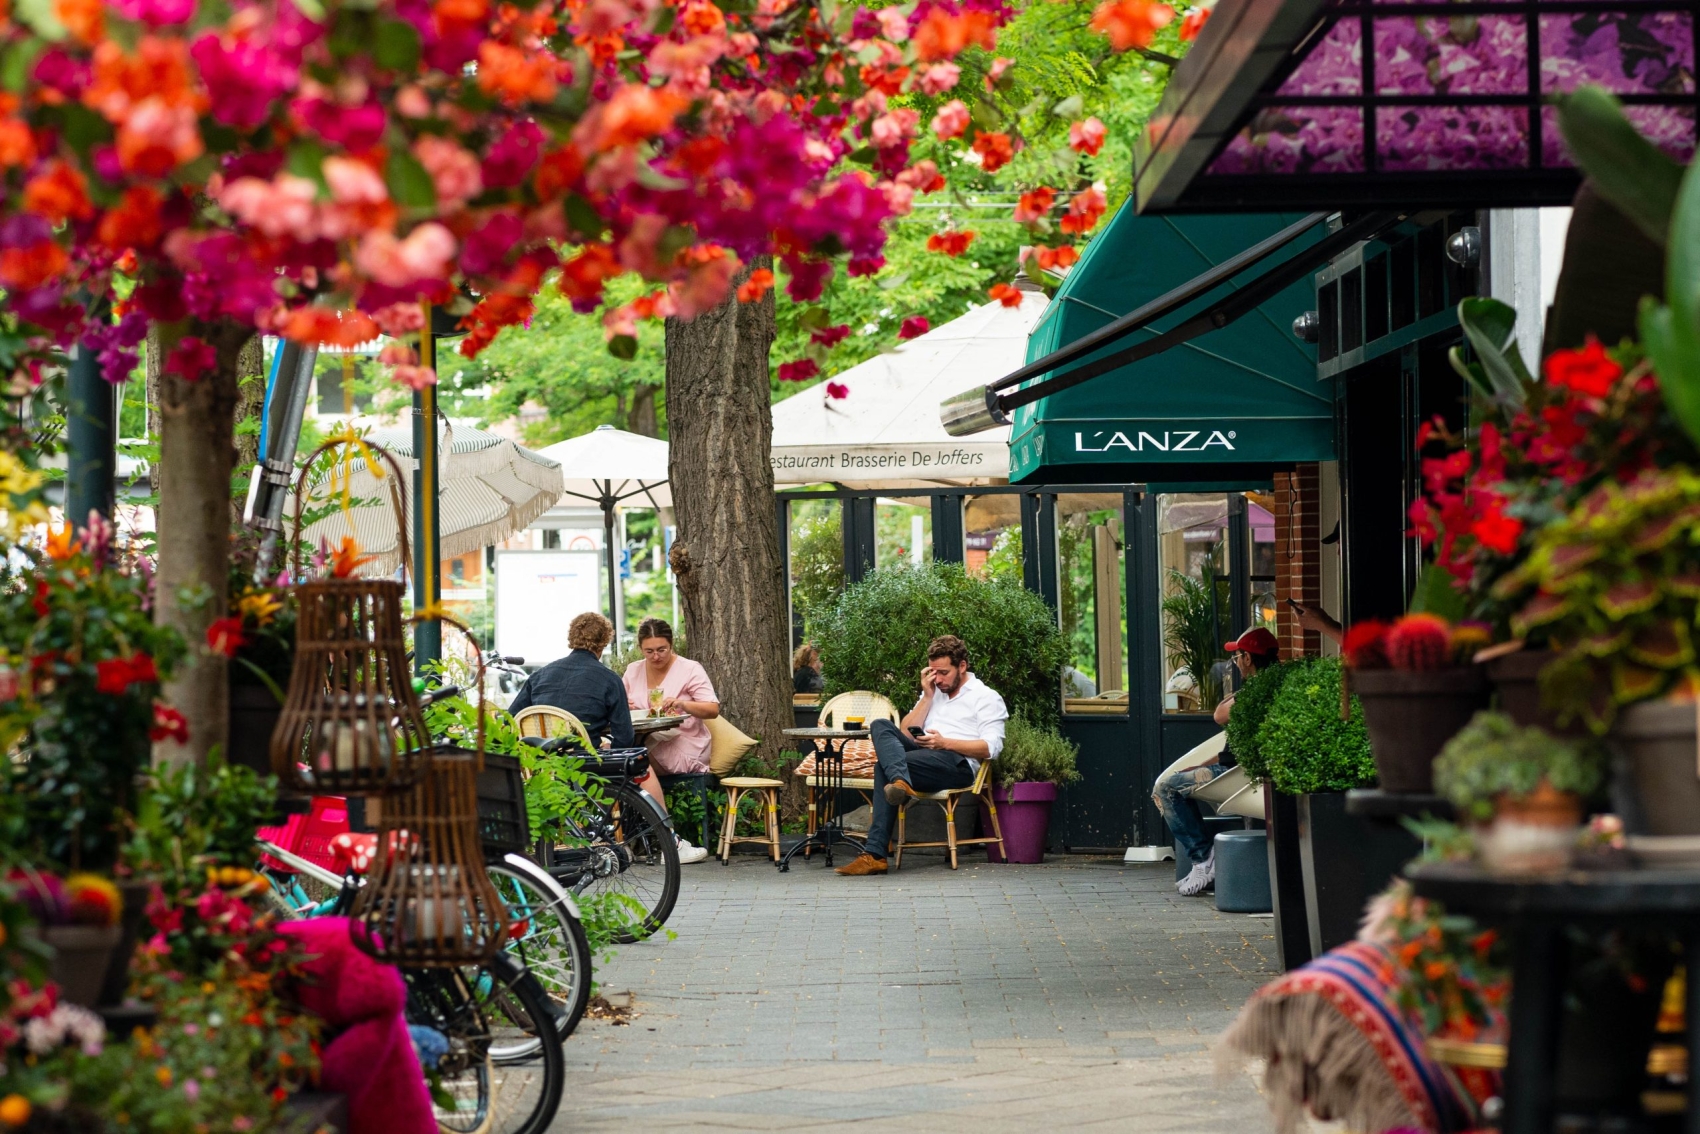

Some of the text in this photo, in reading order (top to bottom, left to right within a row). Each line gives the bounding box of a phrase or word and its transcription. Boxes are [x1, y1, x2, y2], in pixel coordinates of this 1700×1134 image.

[770, 449, 983, 468] estaurant Brasserie De Joffers
